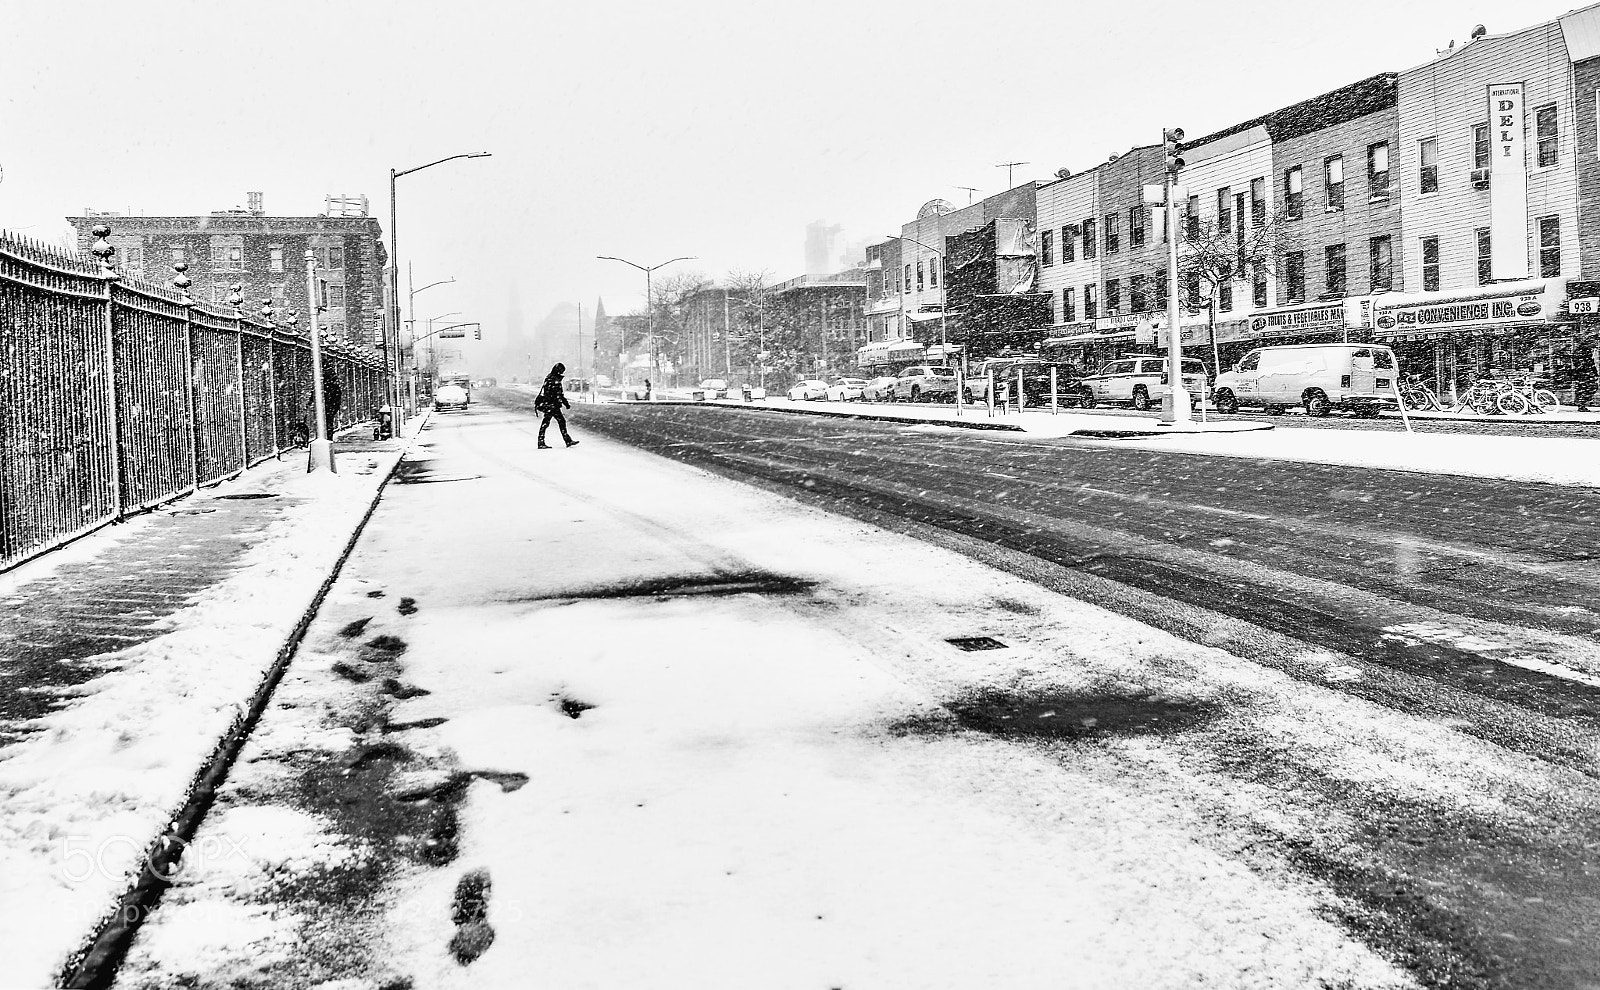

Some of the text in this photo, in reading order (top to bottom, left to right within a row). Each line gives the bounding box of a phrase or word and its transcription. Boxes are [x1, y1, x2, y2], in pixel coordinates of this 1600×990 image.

[1498, 100, 1514, 157] DELI
[1417, 303, 1489, 324] CONVENIENCE
[1574, 302, 1592, 313] 938
[1268, 314, 1287, 326] FRUITS
[1287, 313, 1292, 324] &
[1293, 310, 1329, 324] VEGETABLES
